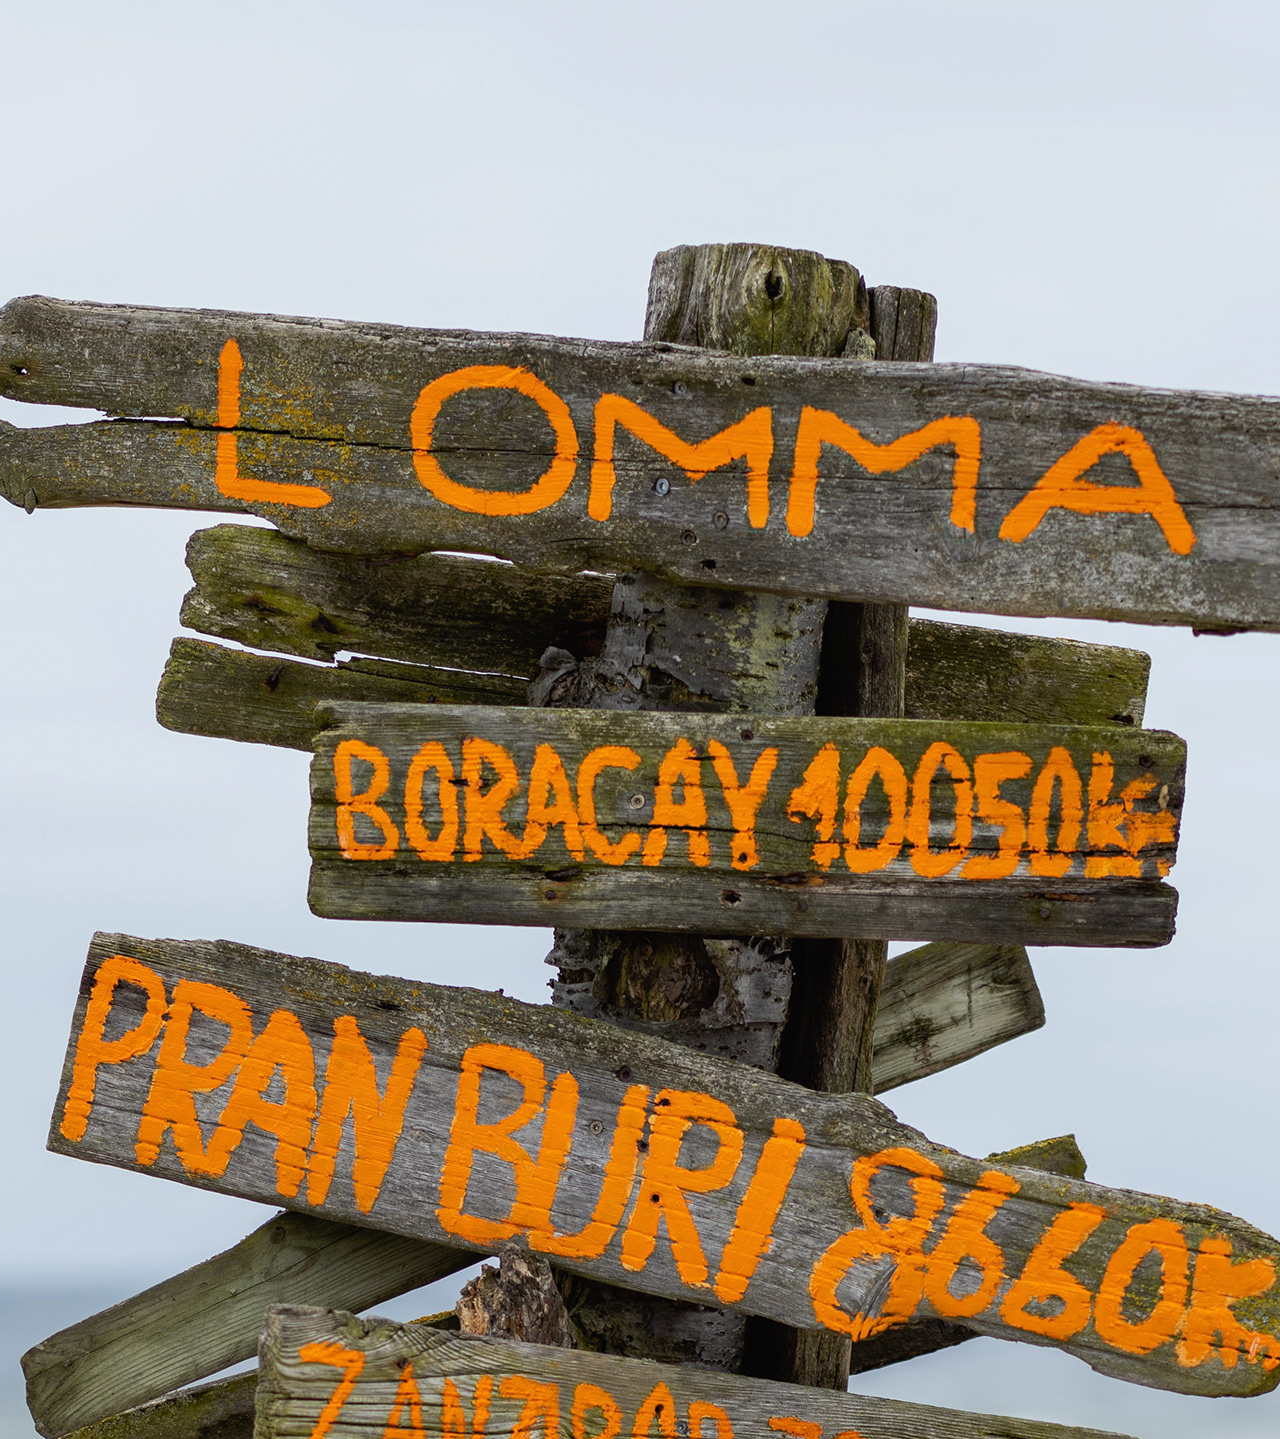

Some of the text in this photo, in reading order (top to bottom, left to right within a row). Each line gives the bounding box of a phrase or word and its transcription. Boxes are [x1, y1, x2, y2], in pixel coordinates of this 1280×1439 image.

[211, 338, 1197, 557] LOMMA
[332, 737, 780, 873] BORACAY
[60, 955, 429, 1215] PRAN
[436, 1042, 807, 1303] BURI
